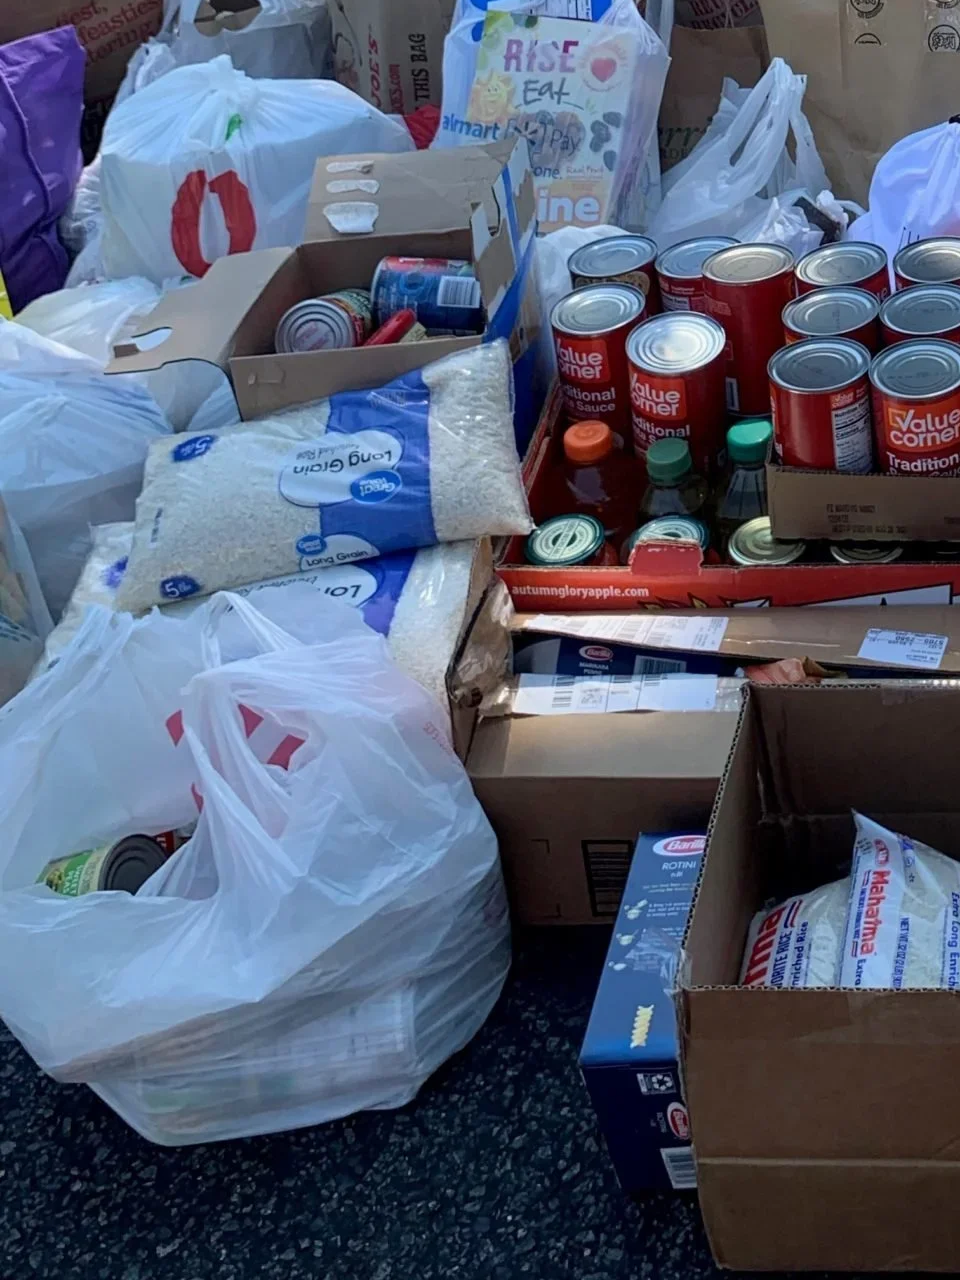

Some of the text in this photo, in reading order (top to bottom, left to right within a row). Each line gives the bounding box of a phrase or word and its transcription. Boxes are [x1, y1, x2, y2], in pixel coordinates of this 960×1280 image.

[408, 32, 430, 102] THIS BAG
[504, 38, 580, 73] RISE
[368, 33, 382, 110] JOE'S
[522, 77, 570, 106] Eat
[576, 400, 616, 412] Sauce
[896, 407, 960, 432] Value
[193, 436, 212, 454] 5
[890, 422, 960, 448] corner
[293, 450, 392, 476] Long Grain
[359, 479, 396, 497] Great
[305, 550, 368, 567] Long Grain
[164, 581, 180, 598] 5
[511, 583, 650, 598] autumngloryapple.com
[662, 861, 697, 870] ROTINI
[859, 869, 892, 956] Mahatma
[950, 891, 959, 916] Extra
[778, 929, 793, 954] RICE
[797, 920, 810, 945] Rice
[948, 920, 958, 949] Long
[854, 957, 868, 986] Extra
